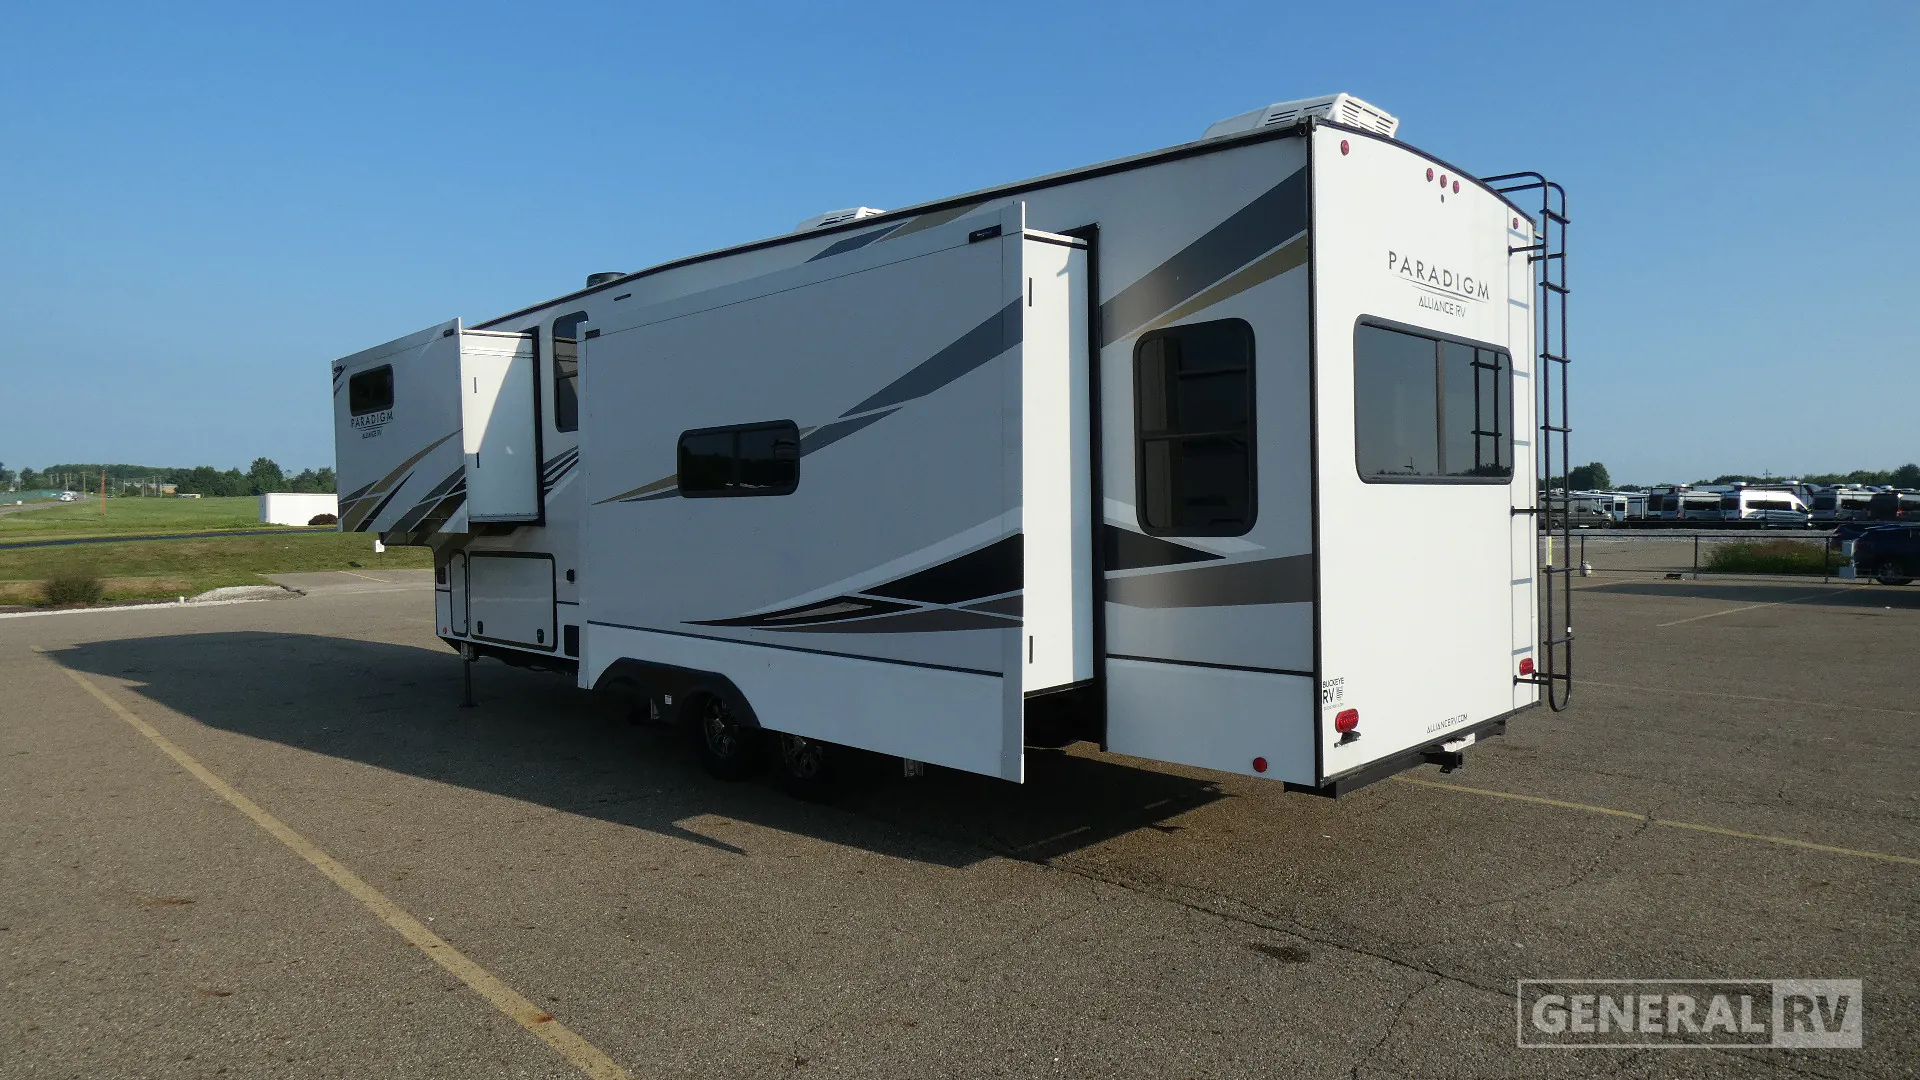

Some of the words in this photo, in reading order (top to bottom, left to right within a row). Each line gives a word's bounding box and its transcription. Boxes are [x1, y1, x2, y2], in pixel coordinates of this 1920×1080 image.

[1388, 250, 1490, 300] PARADIGM
[1418, 295, 1454, 315] ALLIANCE
[1455, 304, 1466, 318] RV
[350, 410, 394, 428] PARADIGM
[1322, 677, 1345, 689] BUCKEYE
[1322, 688, 1335, 705] RV
